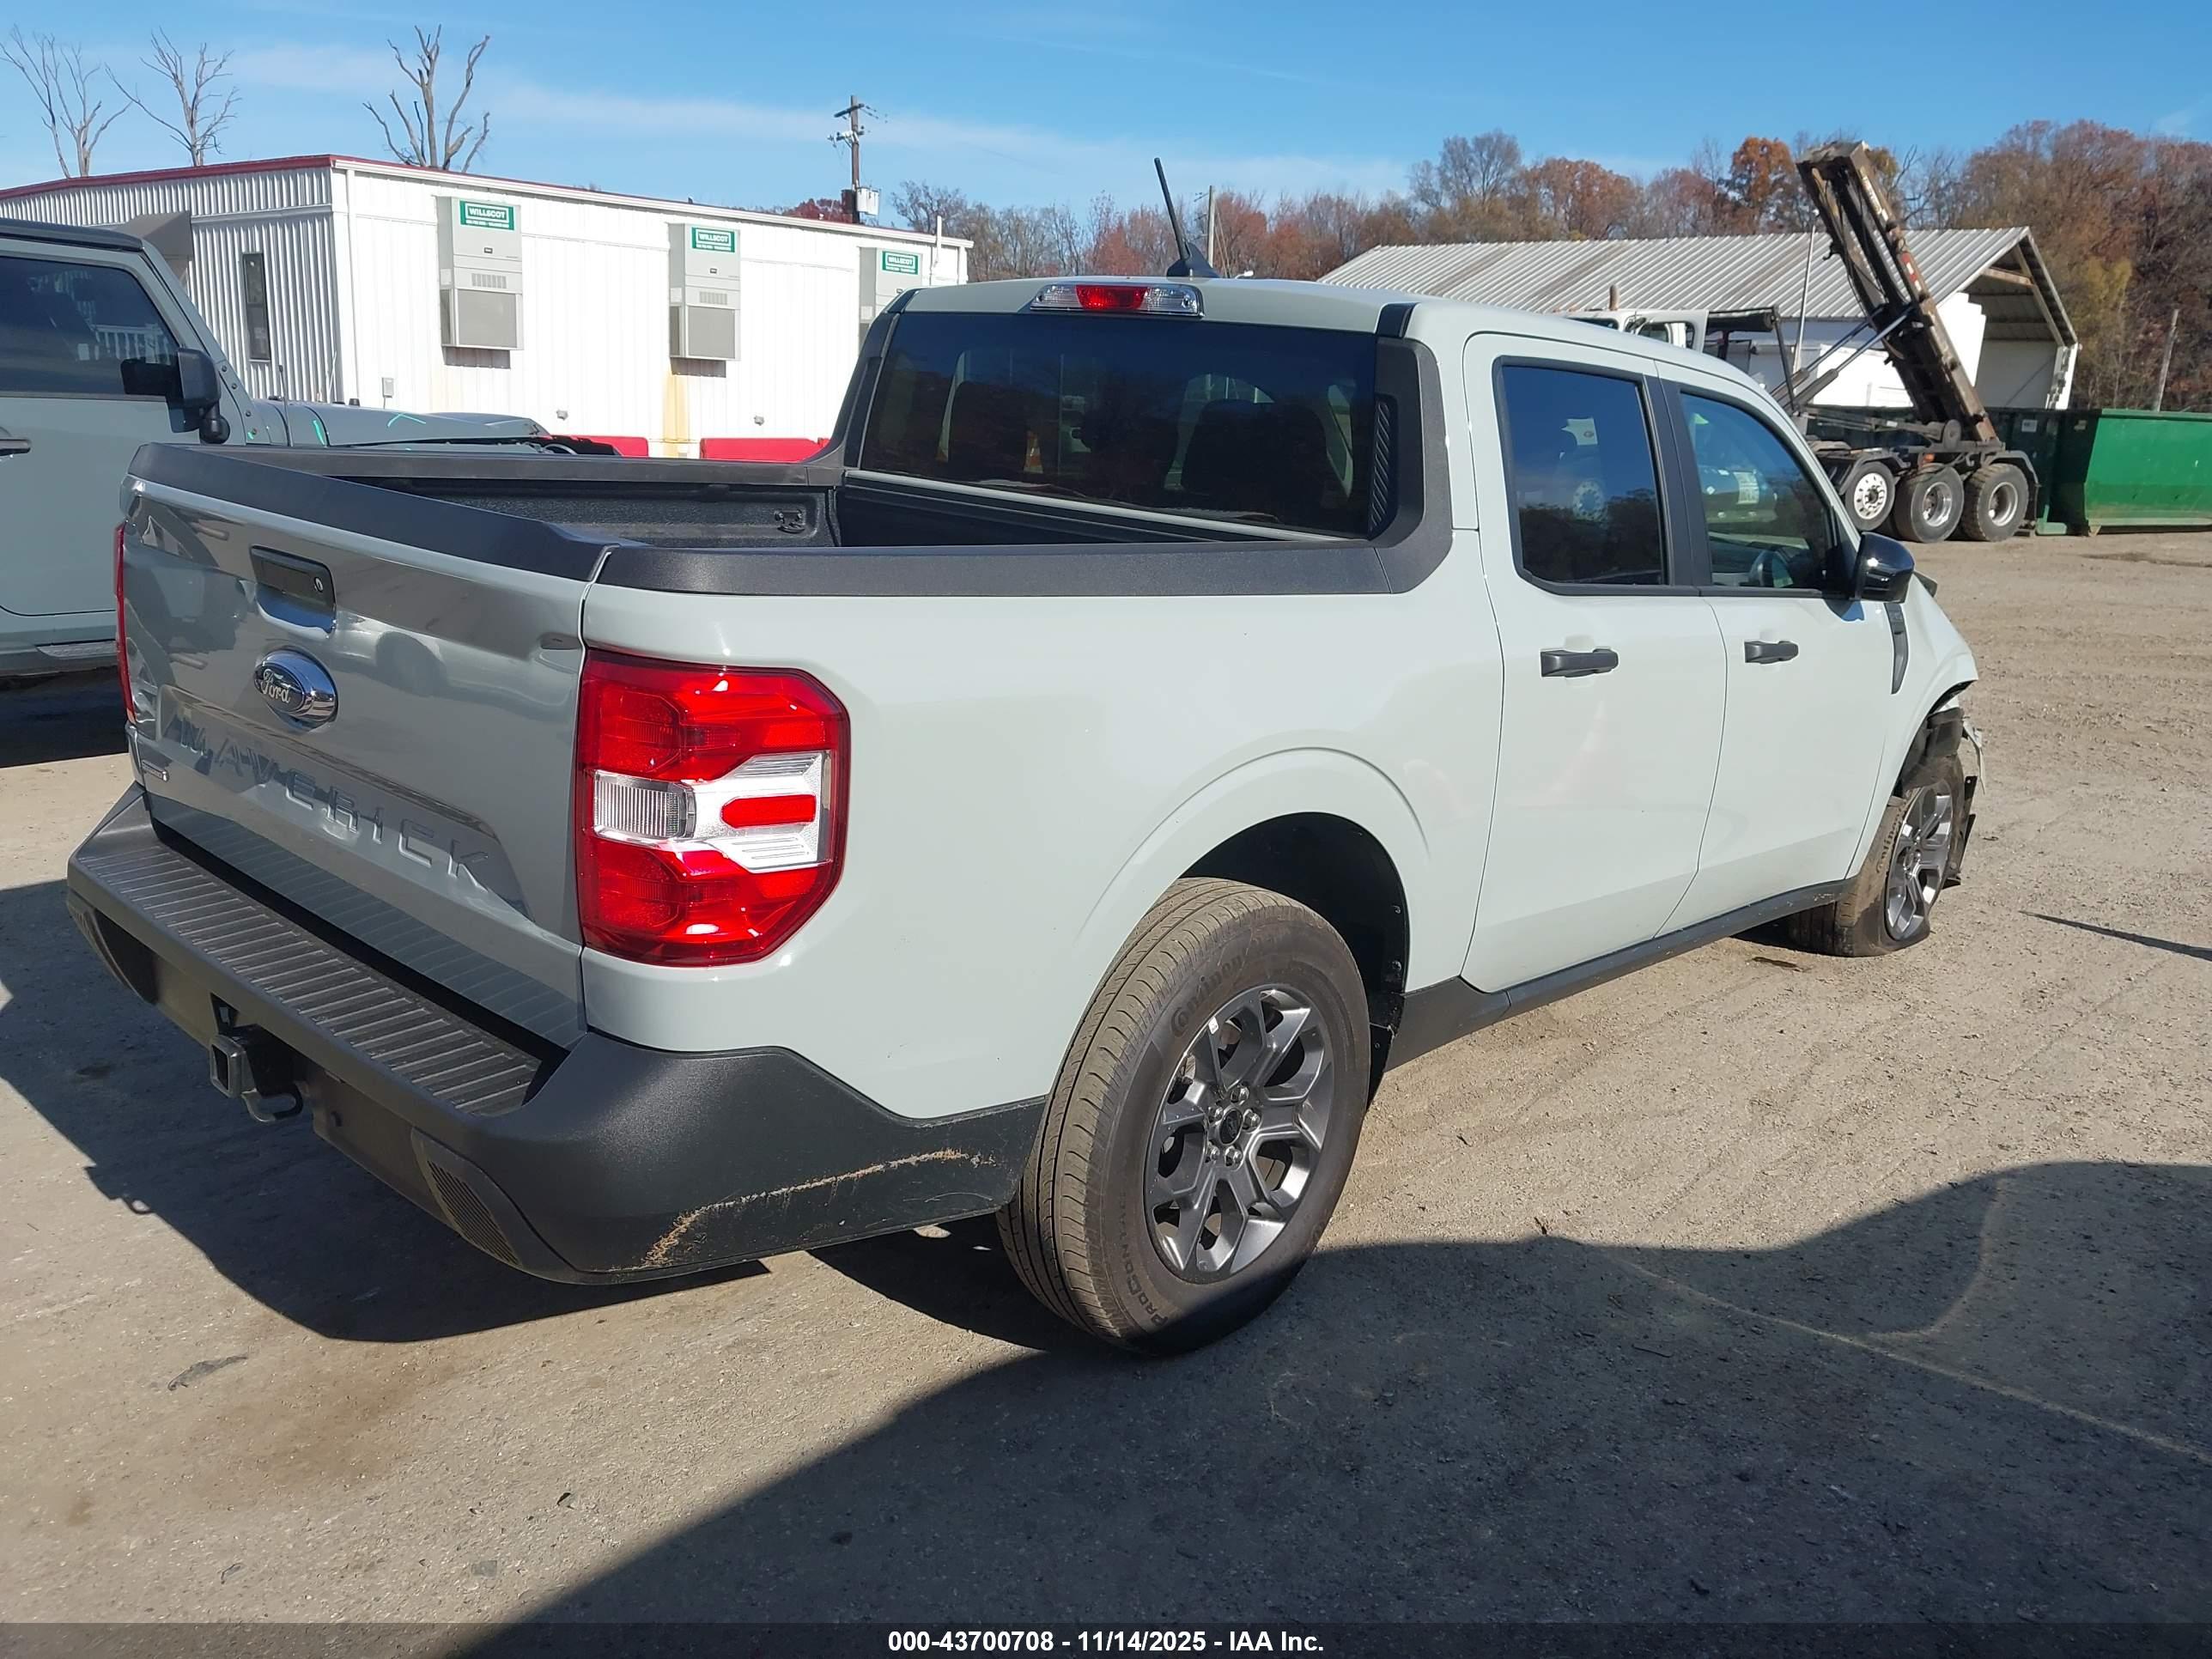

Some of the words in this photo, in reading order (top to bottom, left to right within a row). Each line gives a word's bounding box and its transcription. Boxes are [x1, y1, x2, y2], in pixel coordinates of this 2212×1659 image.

[469, 207, 506, 219] WILLSCOT
[260, 668, 291, 704] Ford
[179, 718, 489, 895] MAVERICK
